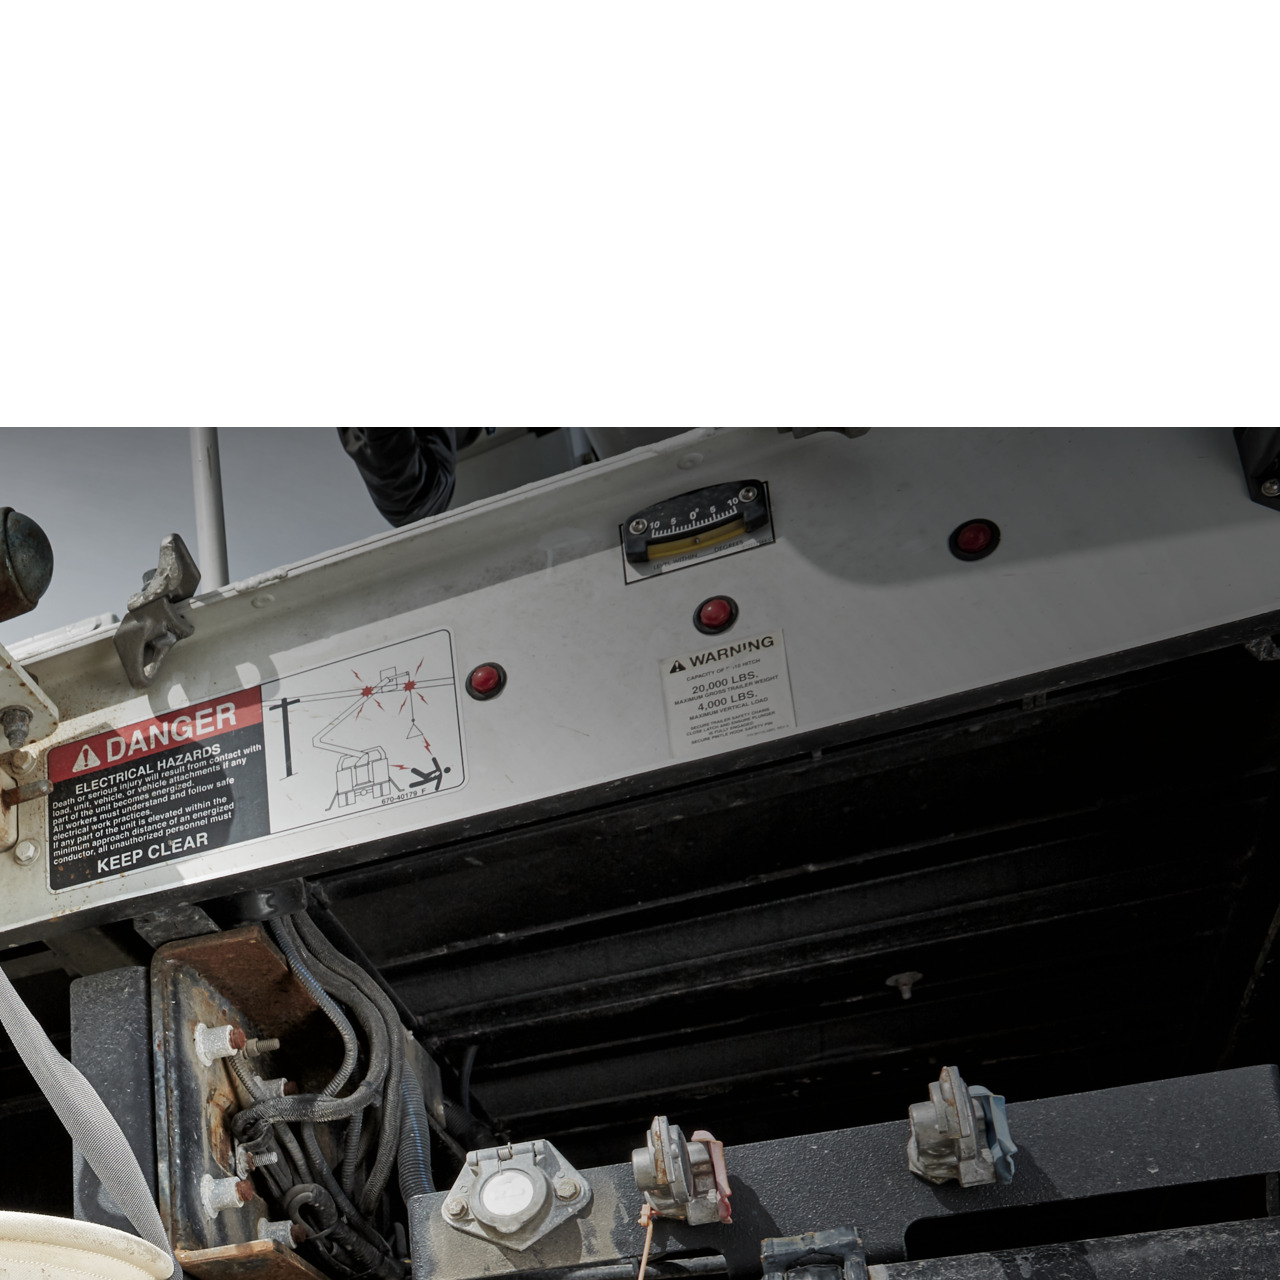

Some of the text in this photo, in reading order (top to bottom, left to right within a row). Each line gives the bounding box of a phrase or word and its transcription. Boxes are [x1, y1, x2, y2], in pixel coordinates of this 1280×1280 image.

[650, 520, 660, 529] 10
[727, 497, 739, 506] 10
[673, 553, 698, 564] WITHIN
[714, 540, 744, 552] DEGREES
[690, 636, 774, 667] WARNING
[686, 670, 715, 681] CAPACITY
[742, 658, 760, 667] HITCH
[692, 671, 758, 694] 20,000 LBS.
[674, 675, 779, 706] MAXIMUM GROSS TRAILER WEIGHT
[698, 690, 758, 712] 4,000 LBS.
[690, 697, 768, 720] MAXIMUM VERTICAL LOAD
[752, 711, 775, 720] PLUNGER
[107, 702, 236, 762] DANGER
[745, 724, 763, 732] SAFETY
[53, 797, 75, 809] Death
[88, 786, 117, 800] serious
[120, 779, 143, 790] injury
[145, 773, 159, 782] will
[162, 766, 185, 778] result
[188, 761, 206, 770] from
[209, 750, 241, 764] contact
[243, 744, 262, 755] with
[76, 744, 221, 794] ELECTRICAL HAZARDS
[53, 806, 72, 817] load,
[74, 801, 92, 811] unit,
[94, 793, 124, 806] vehicle,
[138, 780, 167, 792] vehicle
[169, 764, 220, 784] attachments
[223, 760, 228, 769] if
[231, 758, 247, 766] any
[53, 780, 195, 826] part of the unit becomes energized.
[66, 817, 97, 829] workers
[100, 811, 120, 820] must
[122, 795, 168, 813] understand
[170, 789, 185, 800] and
[188, 784, 214, 795] follow
[216, 777, 235, 787] safe
[382, 790, 418, 804] 670-40179
[53, 810, 152, 841] electrical work practices.
[53, 802, 234, 857] minimum approach distance of an energized
[61, 838, 75, 847] any
[77, 832, 93, 843] part
[95, 830, 104, 838] of
[106, 826, 119, 835] the
[121, 820, 136, 831] unit
[138, 818, 146, 826] is
[148, 807, 182, 823] elevated
[185, 801, 211, 813] within
[213, 796, 228, 805] the
[54, 812, 232, 865] conductor, all unauthorized personnel must
[98, 832, 208, 873] KEEP CLEAR
